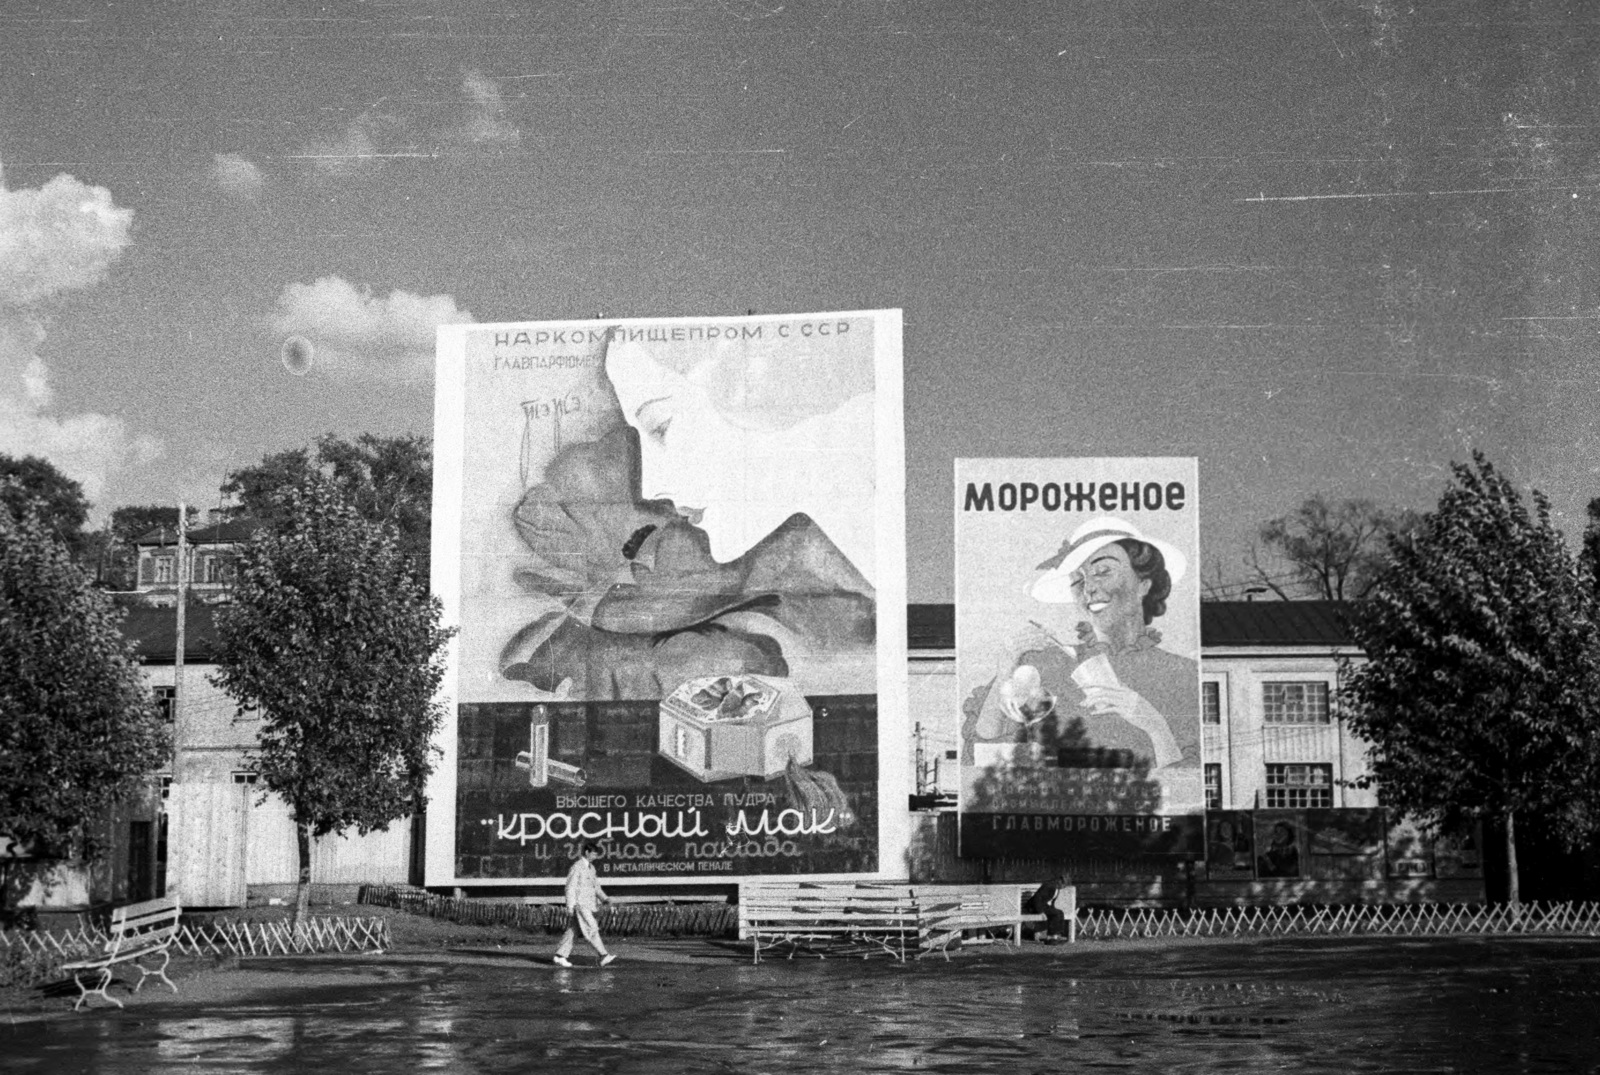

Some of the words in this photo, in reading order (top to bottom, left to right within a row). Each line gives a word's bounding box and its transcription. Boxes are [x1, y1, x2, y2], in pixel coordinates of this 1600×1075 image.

[778, 322, 852, 339] СССР
[556, 795, 627, 809] ВЫСШЕГО
[636, 794, 715, 808] КАЧЕСТВА
[724, 792, 777, 807] ПУДРА
[992, 816, 1172, 832] ГЛАВМОРОЖЕНОЕ
[698, 861, 733, 871] ПЕНАЛЕ
